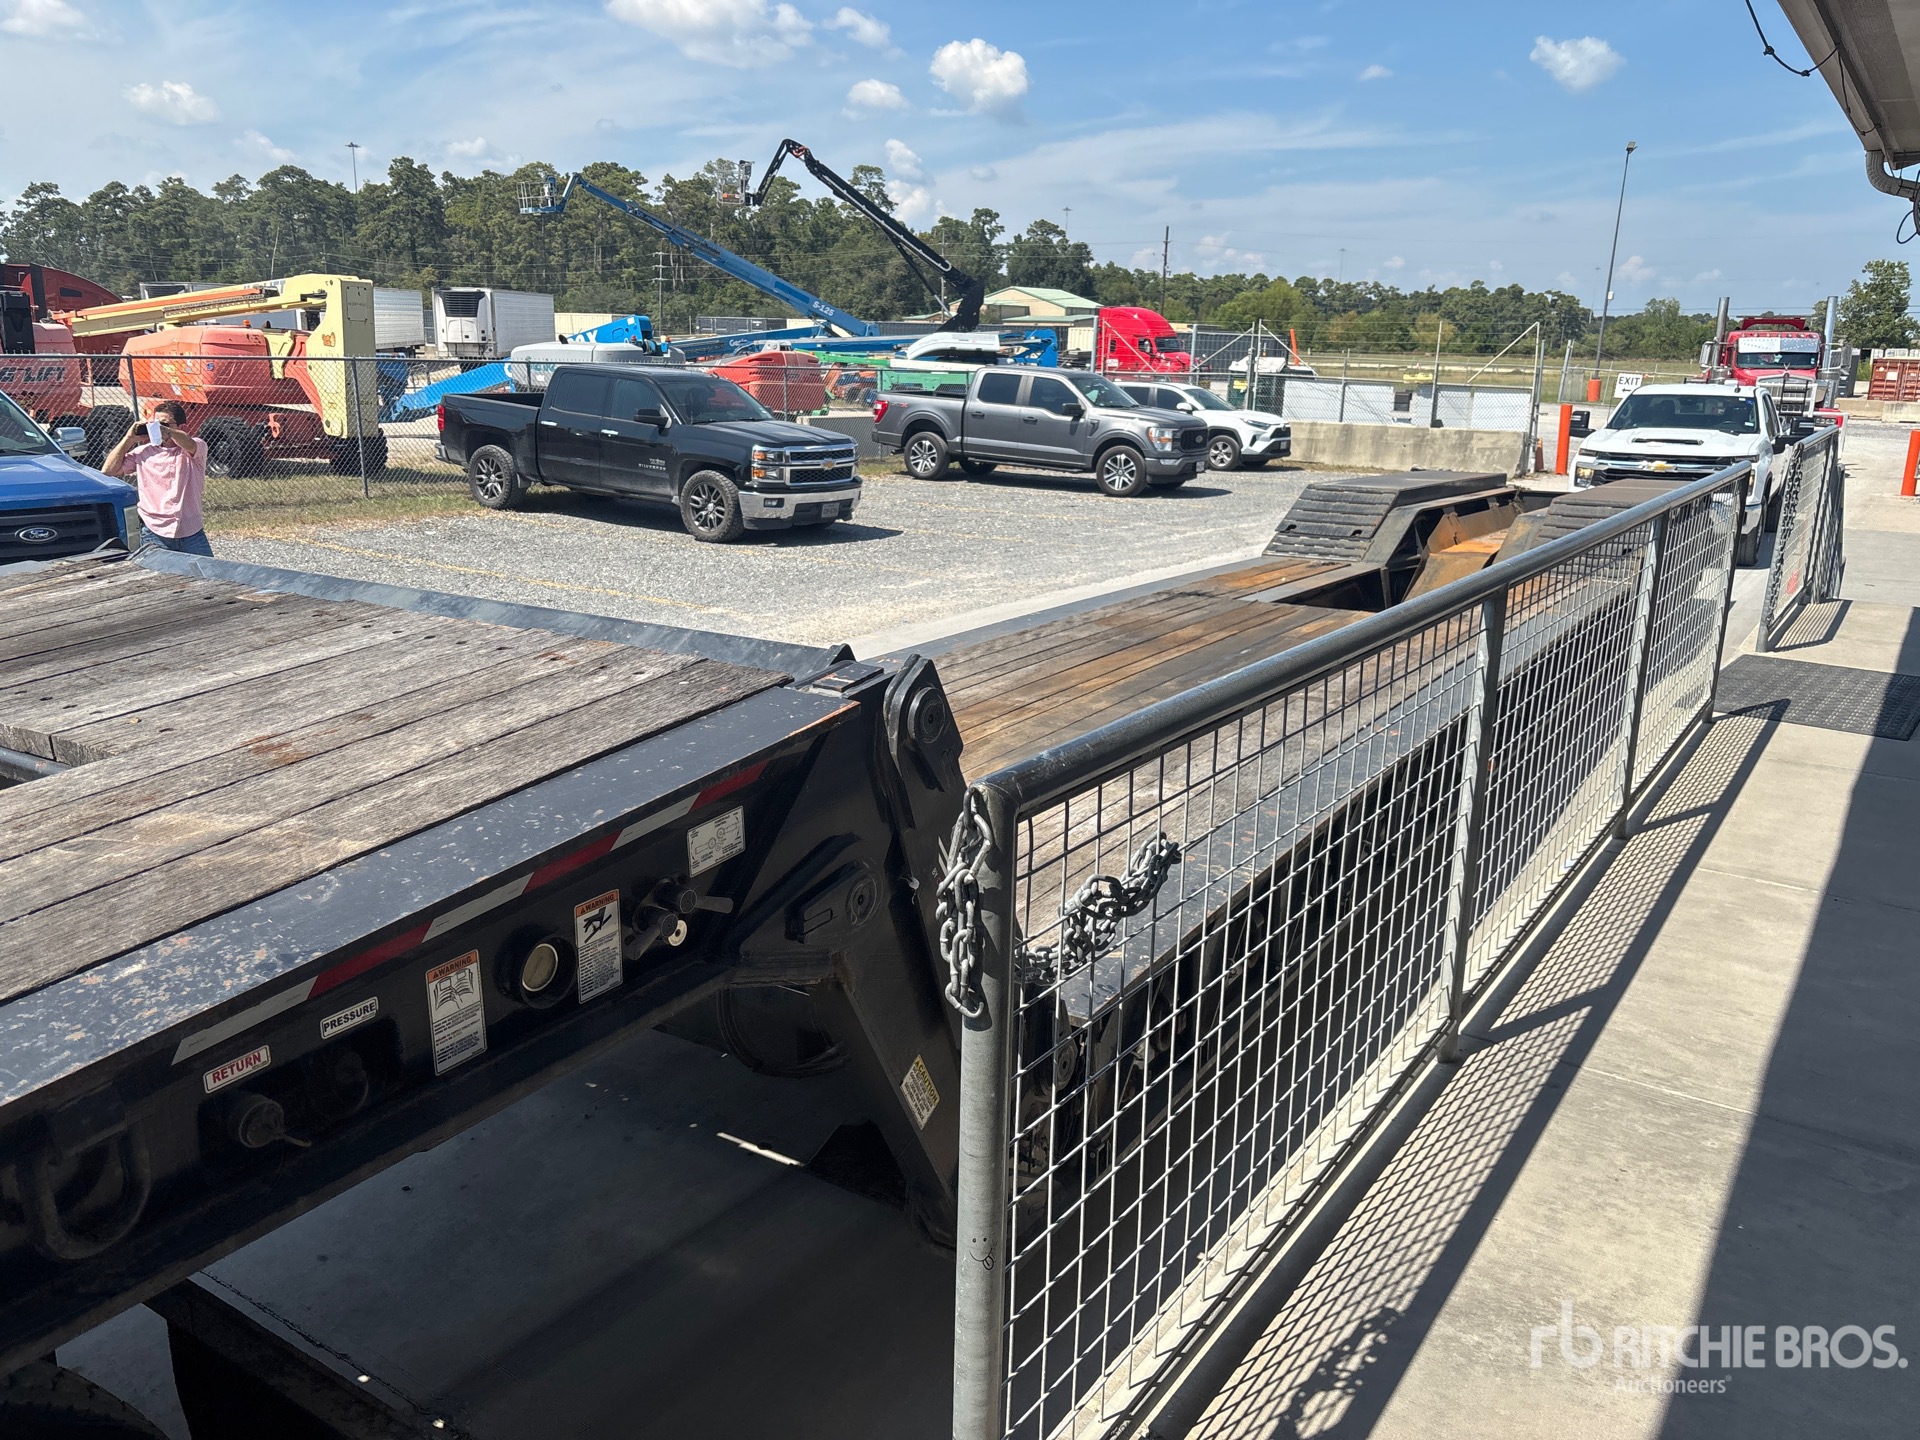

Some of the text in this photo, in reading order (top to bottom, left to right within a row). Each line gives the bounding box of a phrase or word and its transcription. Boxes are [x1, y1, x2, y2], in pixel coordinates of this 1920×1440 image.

[812, 301, 835, 316] S-125
[23, 366, 66, 382] LIFT
[1618, 376, 1640, 386] EXIT
[585, 893, 615, 912] WARNING
[439, 955, 472, 975] WARNING
[323, 1002, 375, 1032] PRESSURE
[212, 1051, 261, 1083] RETURN
[918, 1064, 938, 1105] CAUTION
